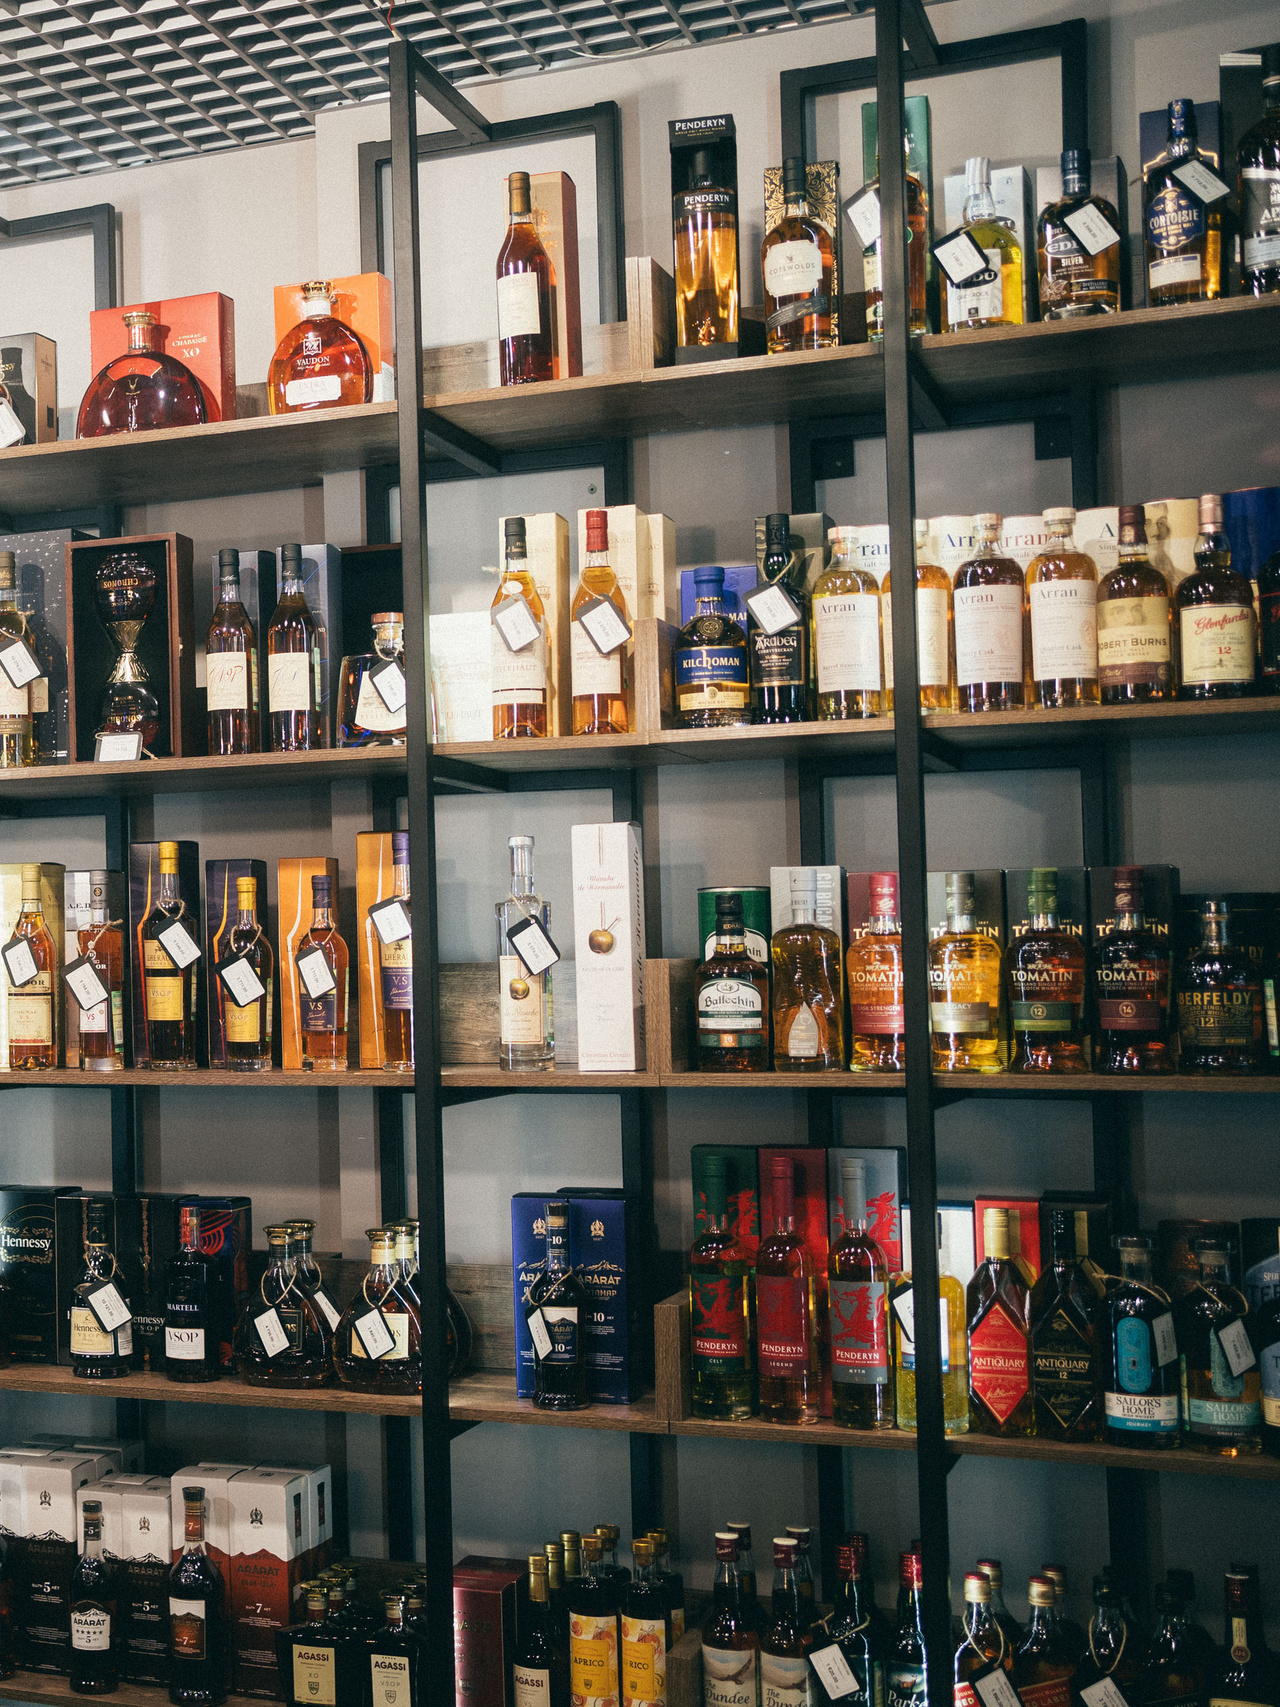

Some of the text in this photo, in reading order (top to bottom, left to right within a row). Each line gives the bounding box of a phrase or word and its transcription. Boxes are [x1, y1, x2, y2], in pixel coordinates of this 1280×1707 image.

[675, 118, 726, 131] PENDERYN
[684, 193, 730, 206] PENDERYN
[1149, 209, 1199, 230] CORTOISIE
[1061, 256, 1084, 266] SILVER
[769, 262, 816, 276] COTSWOLDS
[171, 335, 208, 346] CHABASSE
[182, 347, 200, 359] XO
[296, 355, 330, 366] VAUDON
[1001, 533, 1048, 548] rran
[103, 577, 139, 589] CHRONOS
[959, 592, 994, 606] Arran
[1038, 588, 1078, 600] Arran
[819, 602, 857, 615] Arran
[1131, 637, 1167, 647] BURNS
[1217, 646, 1231, 654] 12
[1011, 970, 1073, 982] TOMATIN
[1096, 970, 1160, 982] TOMATIN
[704, 995, 755, 1009] Ballechin
[1033, 1007, 1043, 1015] 12
[1122, 1005, 1132, 1014] 14
[1200, 1017, 1214, 1027] 12
[723, 1035, 733, 1043] 10
[1, 1234, 52, 1251] Hennessy
[551, 1235, 563, 1245] 10
[132, 1315, 166, 1327] ennessy
[593, 1312, 605, 1322] 10
[73, 1324, 102, 1334] Henness
[554, 1343, 565, 1353] 10
[696, 1340, 738, 1351] PENDERYN
[761, 1342, 804, 1353] PENDERYN
[835, 1349, 880, 1360] PENDERYN
[972, 1356, 1026, 1369] ANTIQUARY
[1035, 1358, 1090, 1370] ANTIQUARY
[1059, 1371, 1068, 1379] 12
[1116, 1396, 1161, 1408] SAILOR'S
[1206, 1402, 1252, 1413] SAILOR'S
[1122, 1405, 1155, 1415] HOME
[1213, 1412, 1247, 1421] HOME
[88, 1525, 94, 1535] 5
[188, 1522, 194, 1530] 7
[236, 1564, 281, 1577] ARARAT
[42, 1582, 51, 1593] 5
[142, 1601, 150, 1611] 5
[255, 1603, 262, 1613] 7
[73, 1617, 107, 1627] ARARAT
[85, 1635, 91, 1644] 5
[182, 1636, 189, 1645] 7
[297, 1651, 329, 1662] AGASSI
[573, 1656, 605, 1668] APRICO
[373, 1660, 406, 1671] AGASSI
[515, 1675, 544, 1688] AGASSI
[705, 1687, 751, 1704] Dundee
[766, 1688, 780, 1699] The
